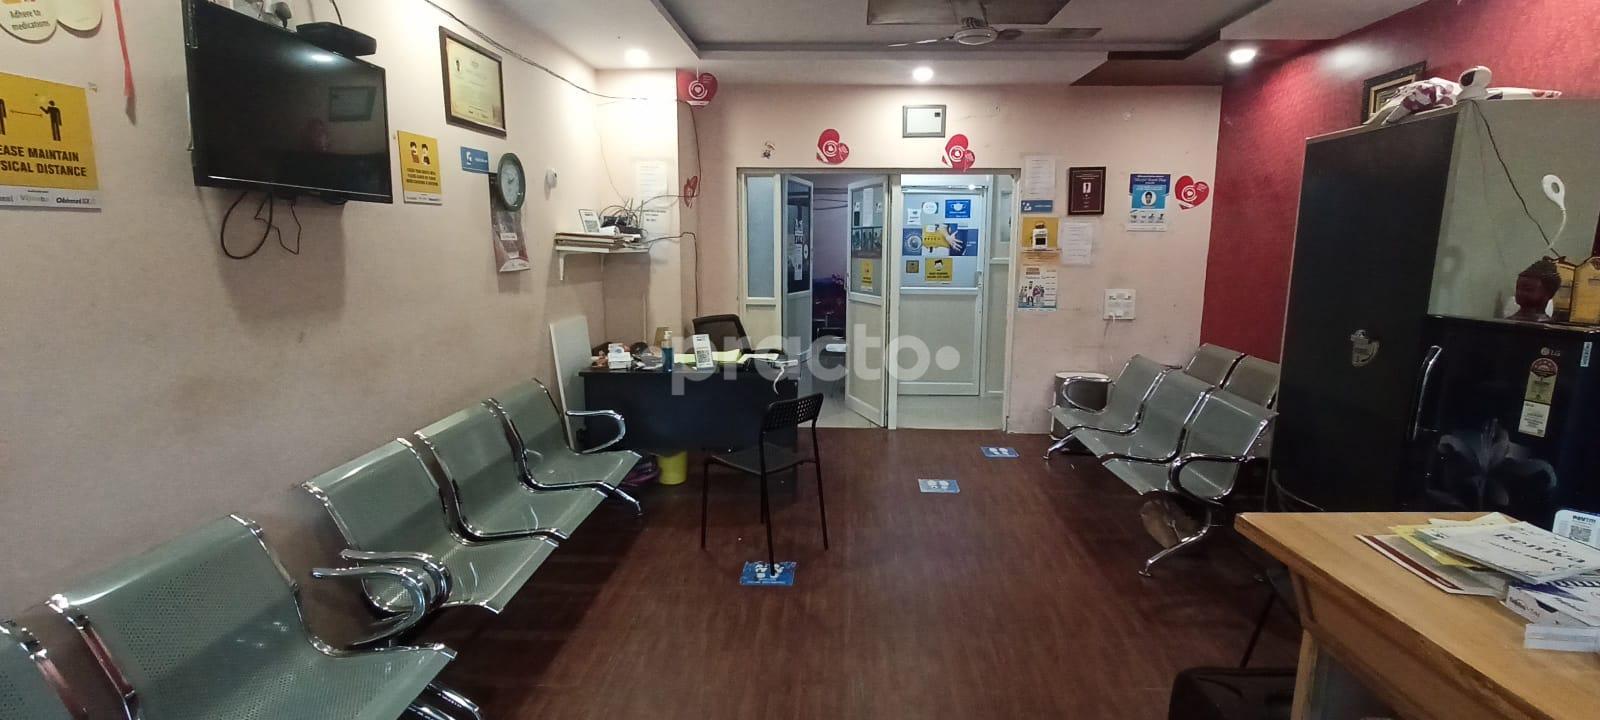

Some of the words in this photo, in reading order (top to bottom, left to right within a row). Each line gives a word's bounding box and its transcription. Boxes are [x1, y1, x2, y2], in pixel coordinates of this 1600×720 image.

[9, 10, 33, 18] Adhere
[28, 148, 80, 162] MAINTAIN
[37, 163, 88, 177] DISTANCE
[1551, 350, 1561, 358] LG
